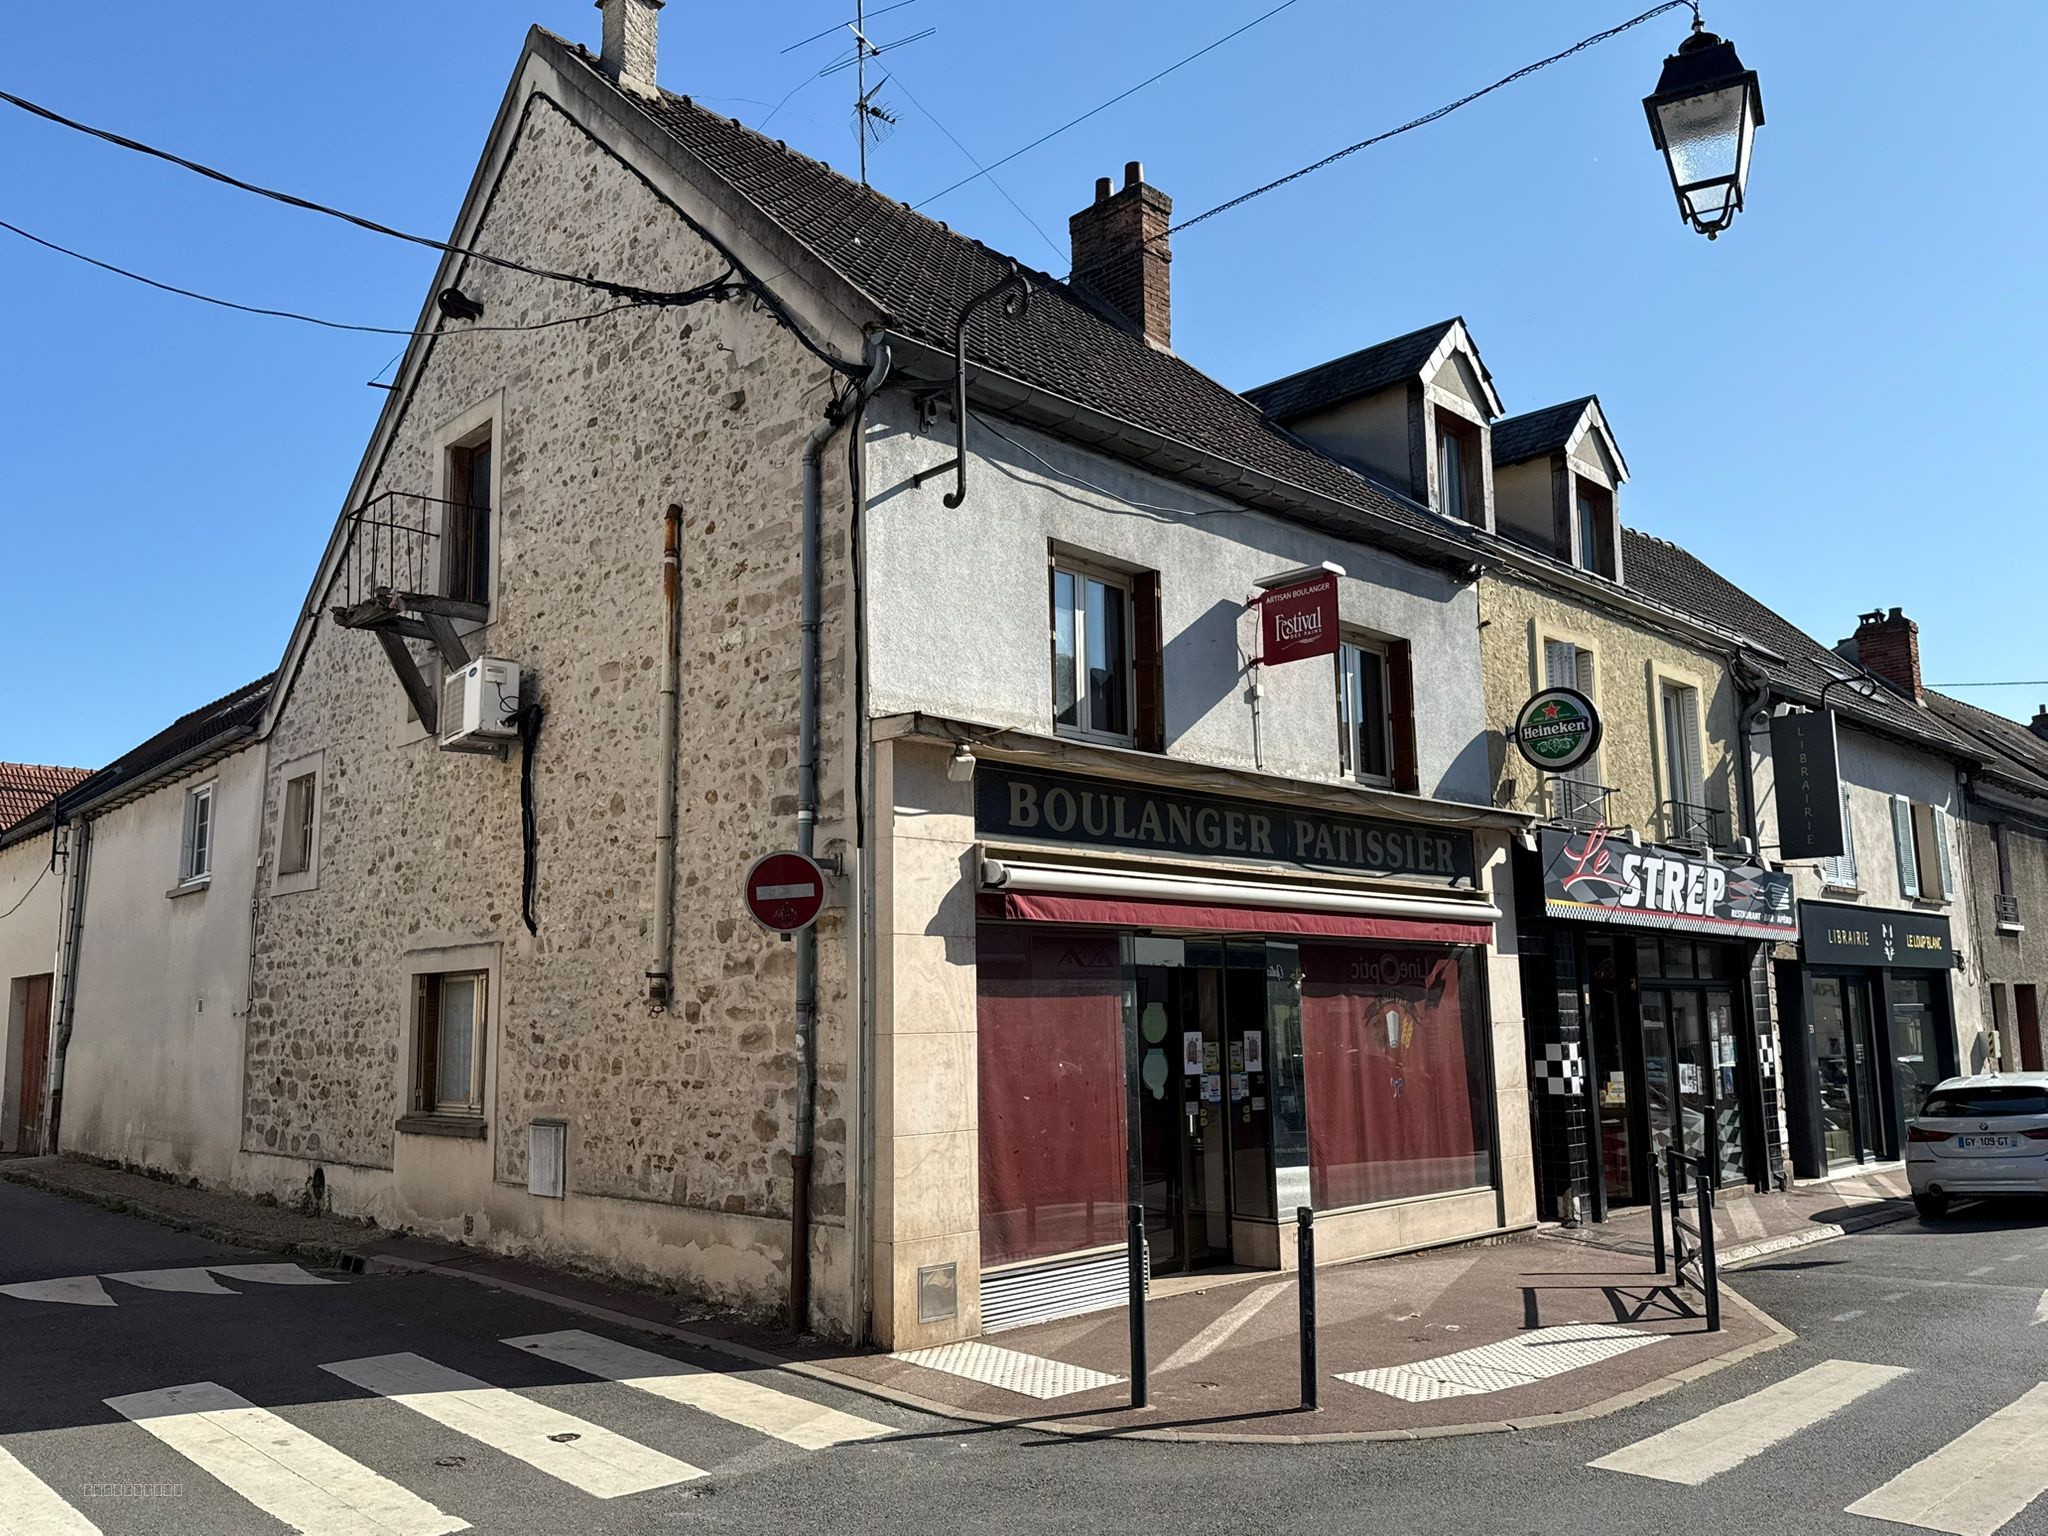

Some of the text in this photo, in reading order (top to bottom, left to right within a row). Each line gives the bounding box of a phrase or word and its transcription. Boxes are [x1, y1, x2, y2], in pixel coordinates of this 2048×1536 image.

[1266, 582, 1330, 605] ARTISAN BOULANGER
[1275, 606, 1322, 641] Festival
[1523, 721, 1586, 740] Heineken
[1797, 727, 1815, 845] LIBRAIRIE
[1008, 781, 1456, 874] BOULANGER PATISSIER
[1564, 822, 1726, 918] Le STREP
[1827, 929, 1942, 950] LIBRAIRIE LE LOUP BLANC
